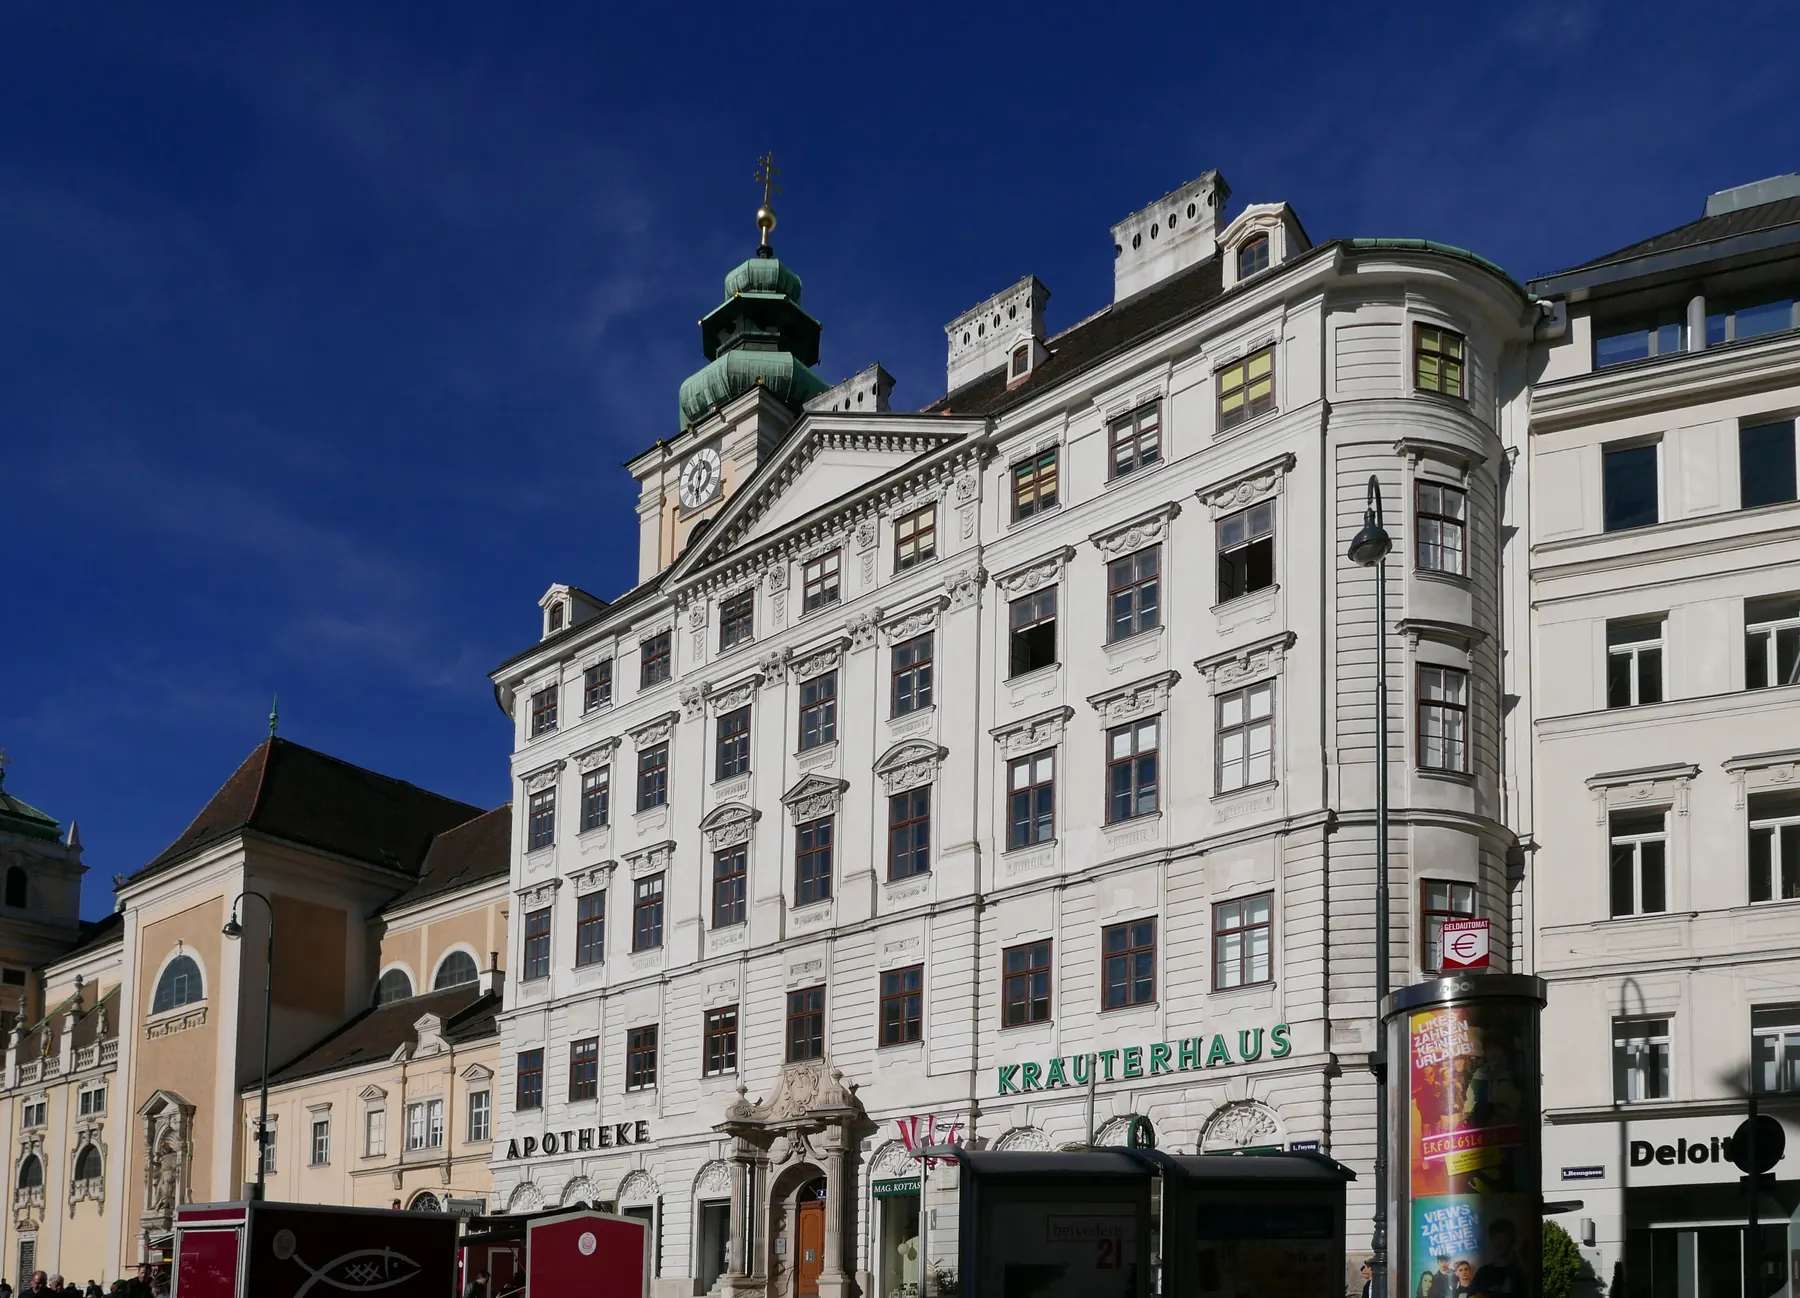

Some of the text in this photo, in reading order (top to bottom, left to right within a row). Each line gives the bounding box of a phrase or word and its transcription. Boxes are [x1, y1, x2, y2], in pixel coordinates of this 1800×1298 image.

[1444, 920, 1488, 931] GELDAUTOMAT
[1414, 1020, 1469, 1047] ZAHLEN
[1418, 1012, 1459, 1033] LIKES
[1415, 1042, 1475, 1069] URLAUB!
[1417, 1032, 1469, 1057] KEINEN
[997, 1023, 1292, 1095] KRÄUTERHAUS
[506, 1119, 651, 1159] APOTHEKE
[1630, 1136, 1736, 1168] Deloit
[874, 1182, 921, 1193] MAG. KOTTAS
[449, 1207, 481, 1217] Aotheke
[1424, 1204, 1470, 1224] VIEWS
[1054, 1222, 1122, 1237] belvedere
[1421, 1213, 1479, 1237] ZAHLEN
[1429, 1226, 1473, 1246] KEINE
[1096, 1239, 1122, 1270] 21
